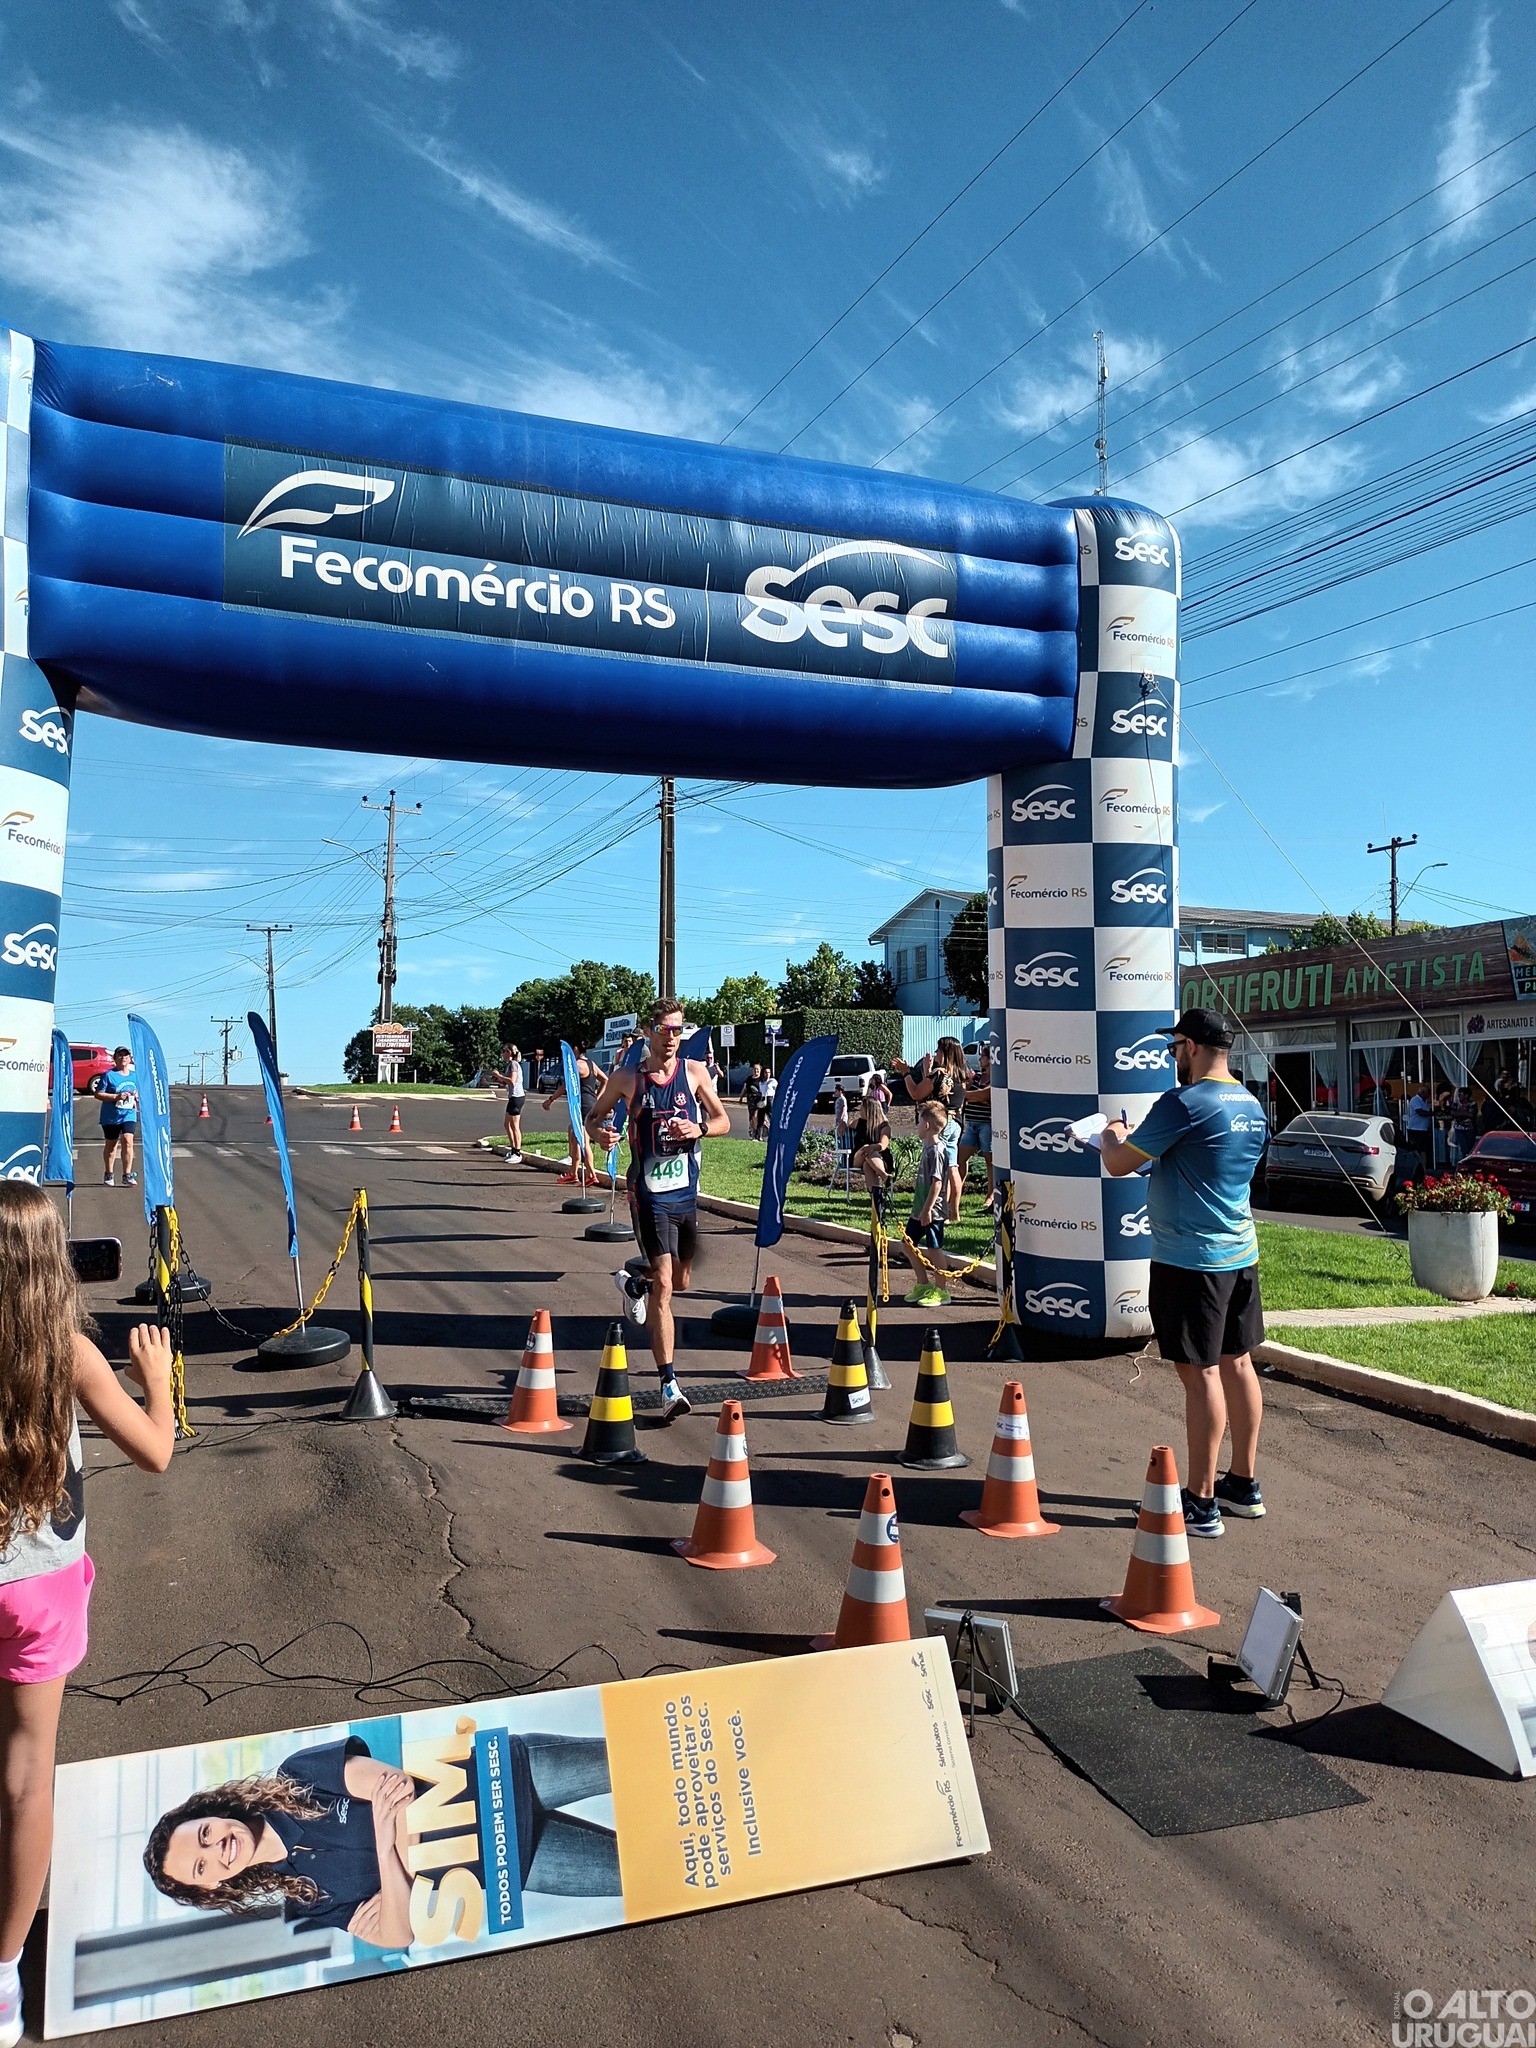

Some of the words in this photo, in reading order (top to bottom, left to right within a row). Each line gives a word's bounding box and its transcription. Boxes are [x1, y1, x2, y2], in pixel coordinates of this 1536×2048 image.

[281, 535, 594, 618] Fecomércio
[611, 582, 676, 630] RS
[1113, 631, 1166, 646] Fecomércio
[1106, 803, 1161, 815] Fecomércio
[1010, 887, 1068, 898] Fecomércio
[1072, 887, 1088, 898] RS
[1109, 971, 1164, 981] Fecomércio
[1182, 964, 1333, 1014] ORTIFRUTI
[1343, 951, 1485, 995] AMETISTA
[1487, 1017, 1528, 1029] ARTESANATO
[1014, 1053, 1072, 1065] Fecomércio
[1075, 1054, 1092, 1066] RS
[651, 1159, 683, 1180] 449
[1019, 1215, 1077, 1231] Fecomércio
[1081, 1220, 1097, 1231] RS
[681, 1695, 693, 1718] os
[697, 1701, 713, 1751] Sesc.
[486, 1736, 500, 1778] SESC.
[664, 1701, 684, 1770] mundo
[727, 1709, 745, 1762] você.
[933, 1722, 946, 1768] Sindicatos
[490, 1779, 502, 1809] SER
[686, 1723, 708, 1827] aproveitar
[703, 1758, 718, 1785] do
[943, 1779, 951, 1793] RS
[673, 1777, 690, 1827] todo
[738, 1767, 762, 1856] Inclusive
[947, 1794, 963, 1848] Fecomércio
[494, 1811, 508, 1866] PODEM
[709, 1790, 731, 1876] serviços
[685, 1832, 700, 1887] Aqui,
[697, 1834, 719, 1889] pode
[500, 1866, 512, 1925] TODOS
